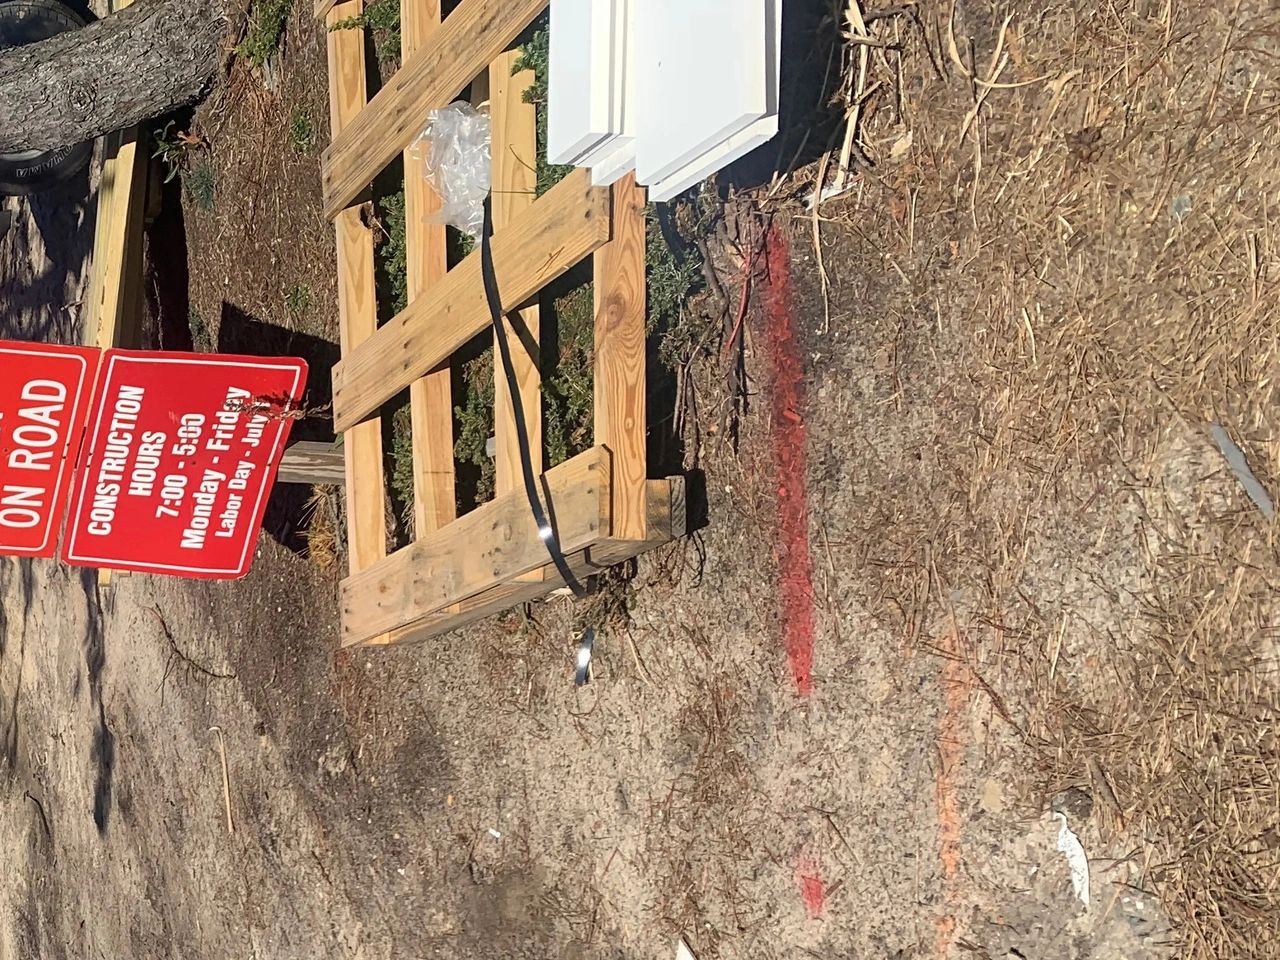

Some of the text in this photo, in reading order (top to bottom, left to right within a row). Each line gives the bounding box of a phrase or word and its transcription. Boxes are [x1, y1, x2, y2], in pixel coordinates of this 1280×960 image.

[7, 379, 67, 471] ROAD
[171, 413, 206, 456] 5:00
[241, 414, 269, 448] July
[87, 385, 145, 536] CONSTRUCTION
[127, 431, 167, 497] HOURS
[180, 468, 227, 549] Monday
[205, 386, 251, 451] Friday
[227, 460, 256, 490] Day
[155, 474, 188, 518] 7:00
[214, 493, 242, 538] Labor
